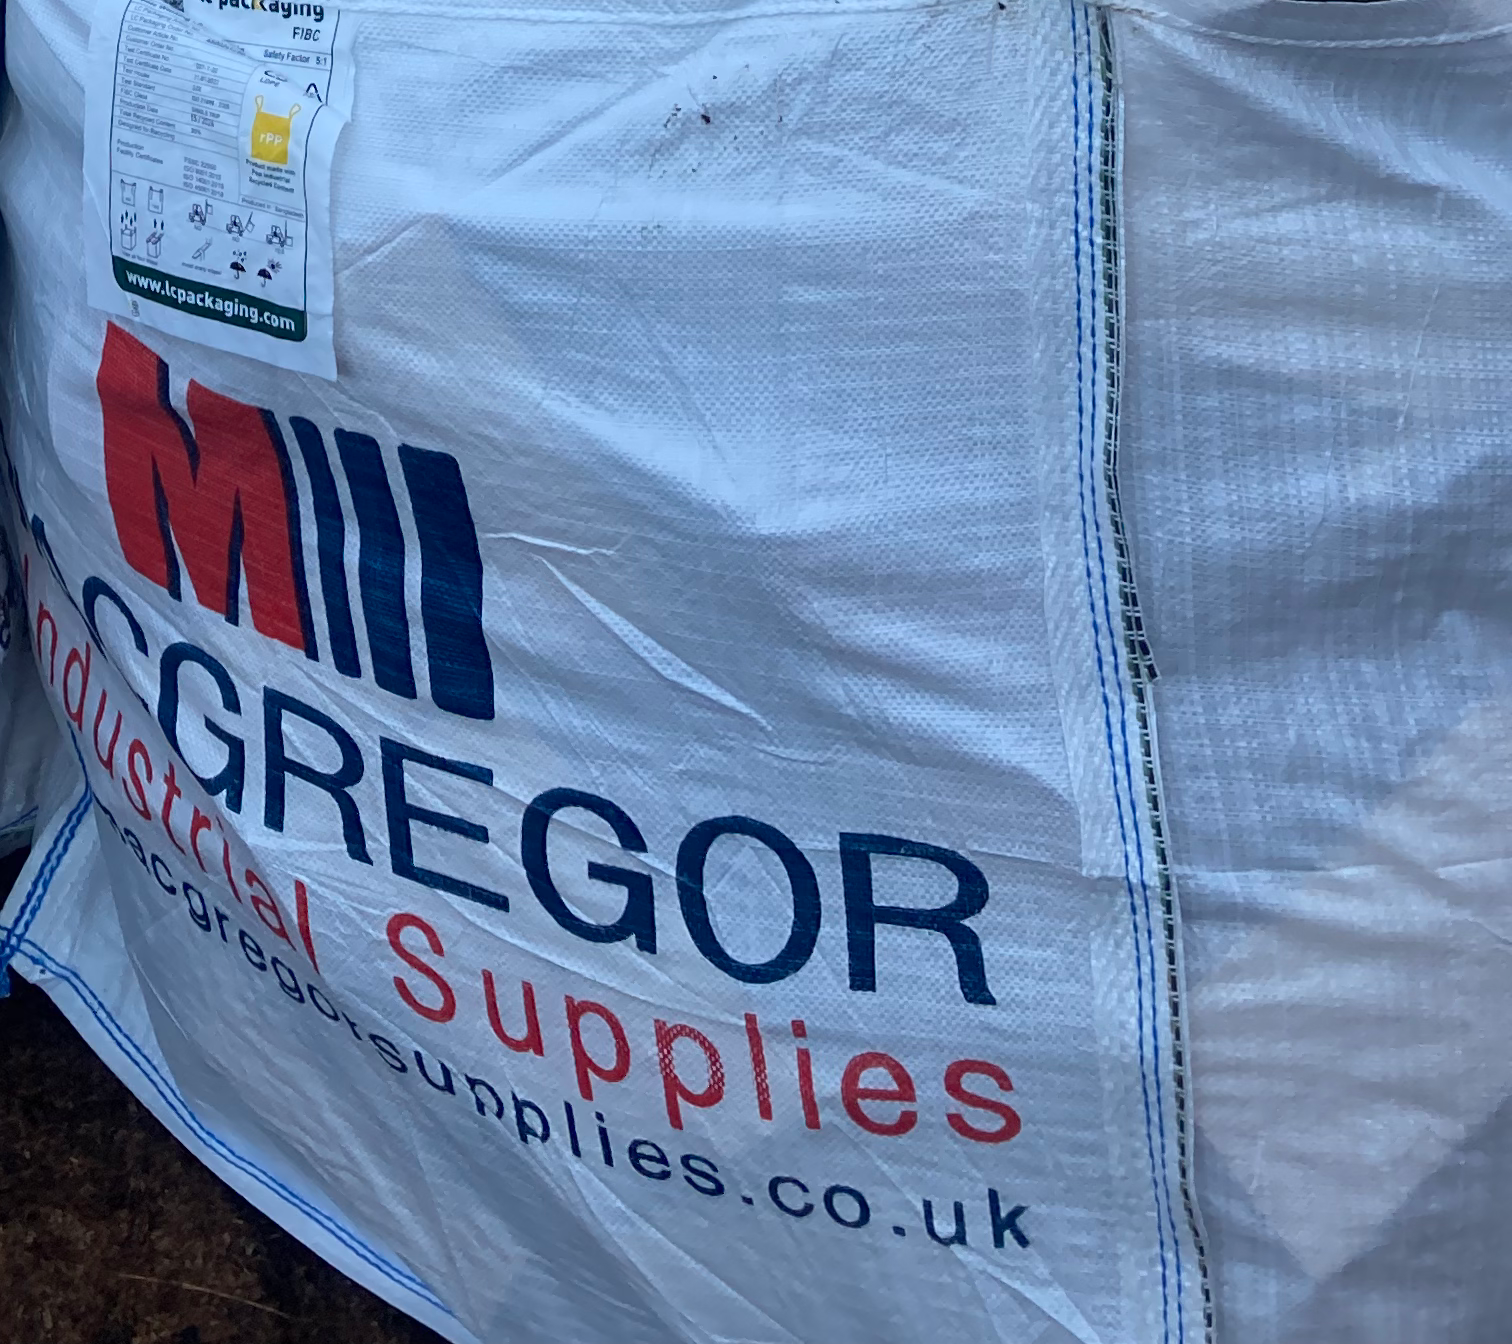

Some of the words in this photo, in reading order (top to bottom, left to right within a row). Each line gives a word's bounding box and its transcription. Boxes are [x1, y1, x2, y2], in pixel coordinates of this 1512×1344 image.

[292, 26, 321, 42] FIBC
[263, 49, 285, 62] Safety
[286, 52, 311, 63] Factor
[125, 270, 296, 331] www.lcpackaging.com
[385, 911, 1022, 1144] Supplies
